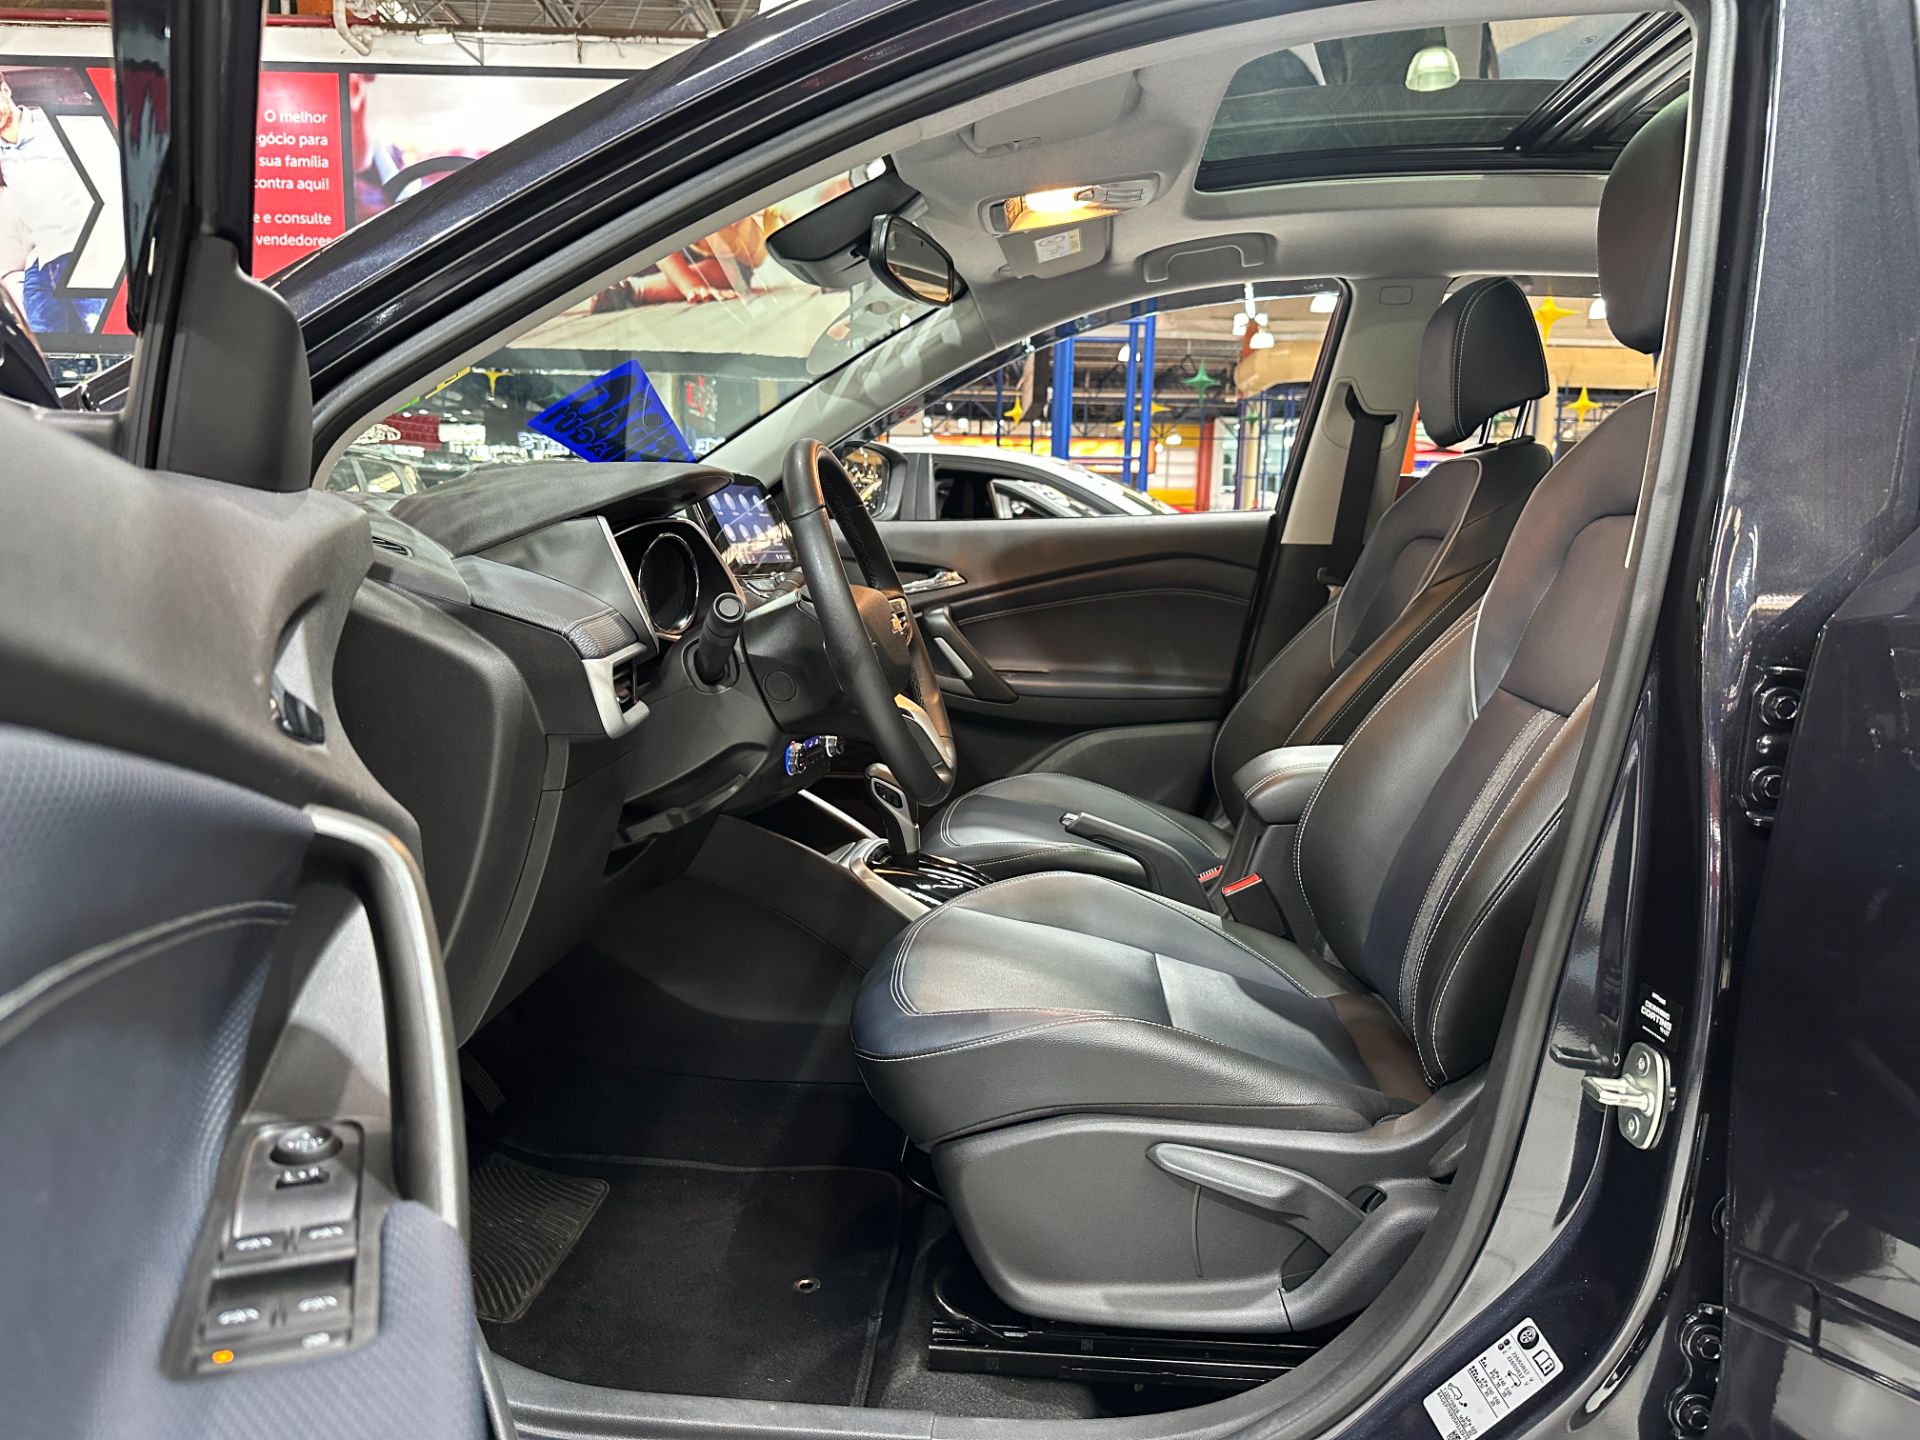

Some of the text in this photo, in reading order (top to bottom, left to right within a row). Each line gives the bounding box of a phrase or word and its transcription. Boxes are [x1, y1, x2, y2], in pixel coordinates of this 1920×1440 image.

[264, 109, 328, 124] O melhor
[299, 135, 329, 149] para
[259, 154, 329, 169] sua família
[297, 177, 330, 193] aqui!
[263, 213, 272, 224] e
[274, 212, 333, 226] consulte
